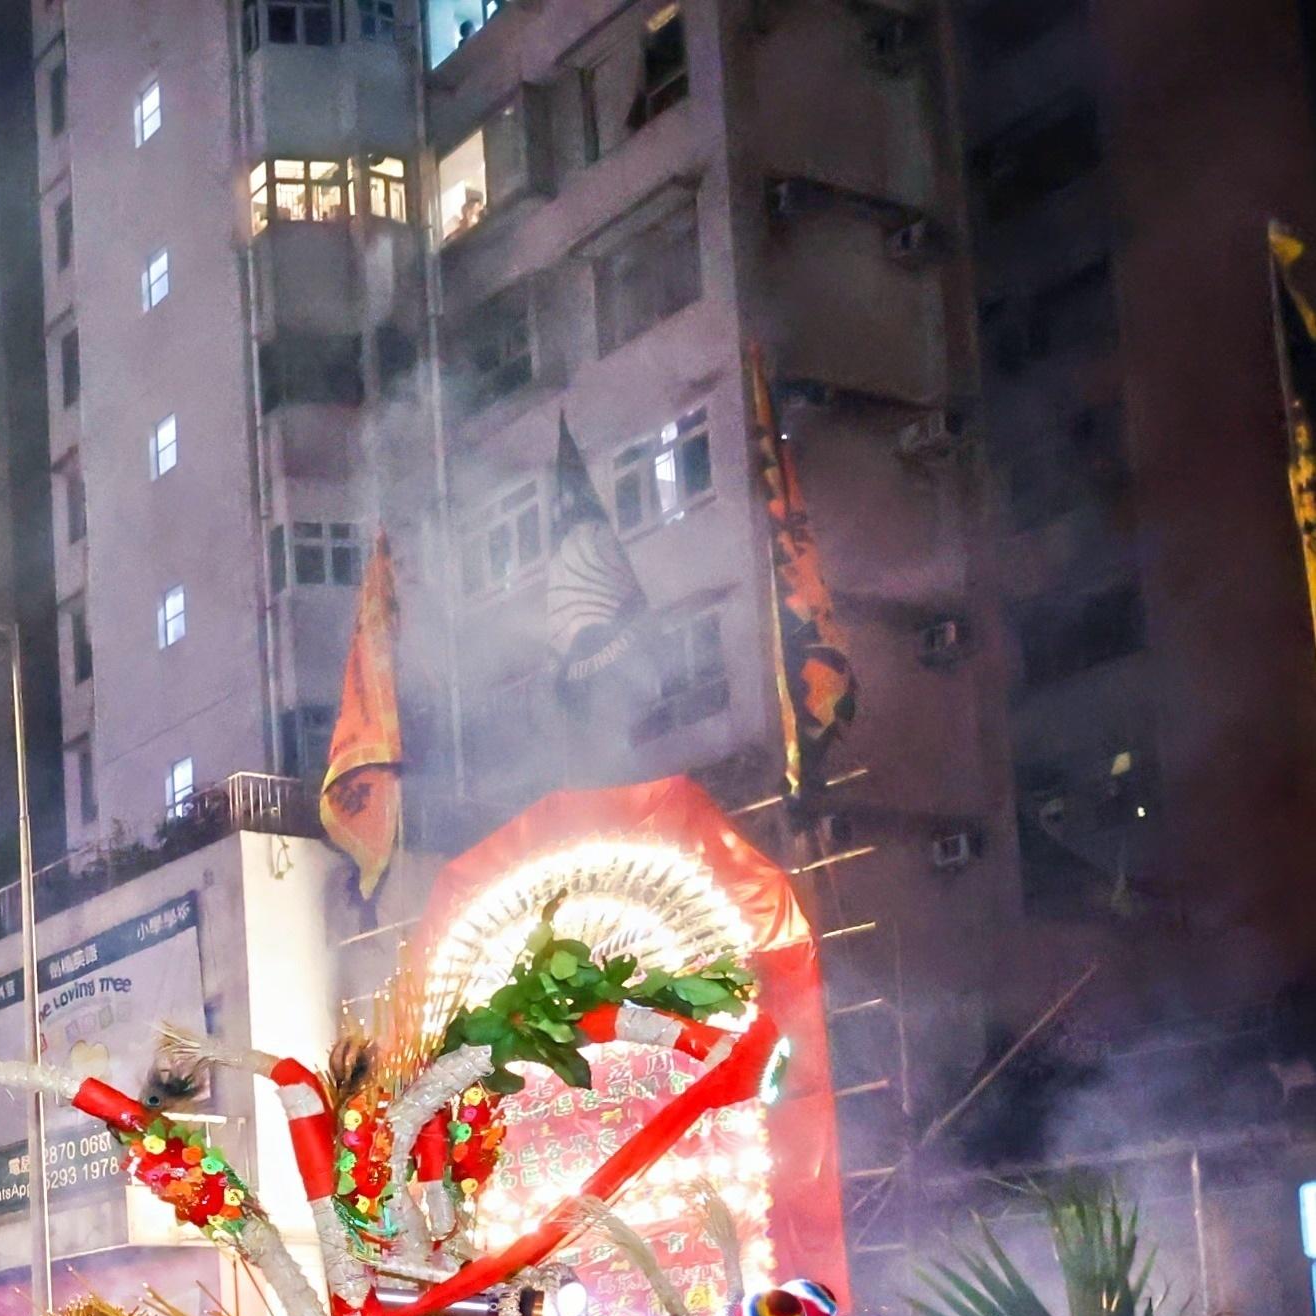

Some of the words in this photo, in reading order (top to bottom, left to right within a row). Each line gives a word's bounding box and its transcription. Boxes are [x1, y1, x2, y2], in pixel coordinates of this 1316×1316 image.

[53, 978, 96, 1011] Loving
[98, 974, 133, 994] Tree
[81, 1157, 120, 1180] 1978
